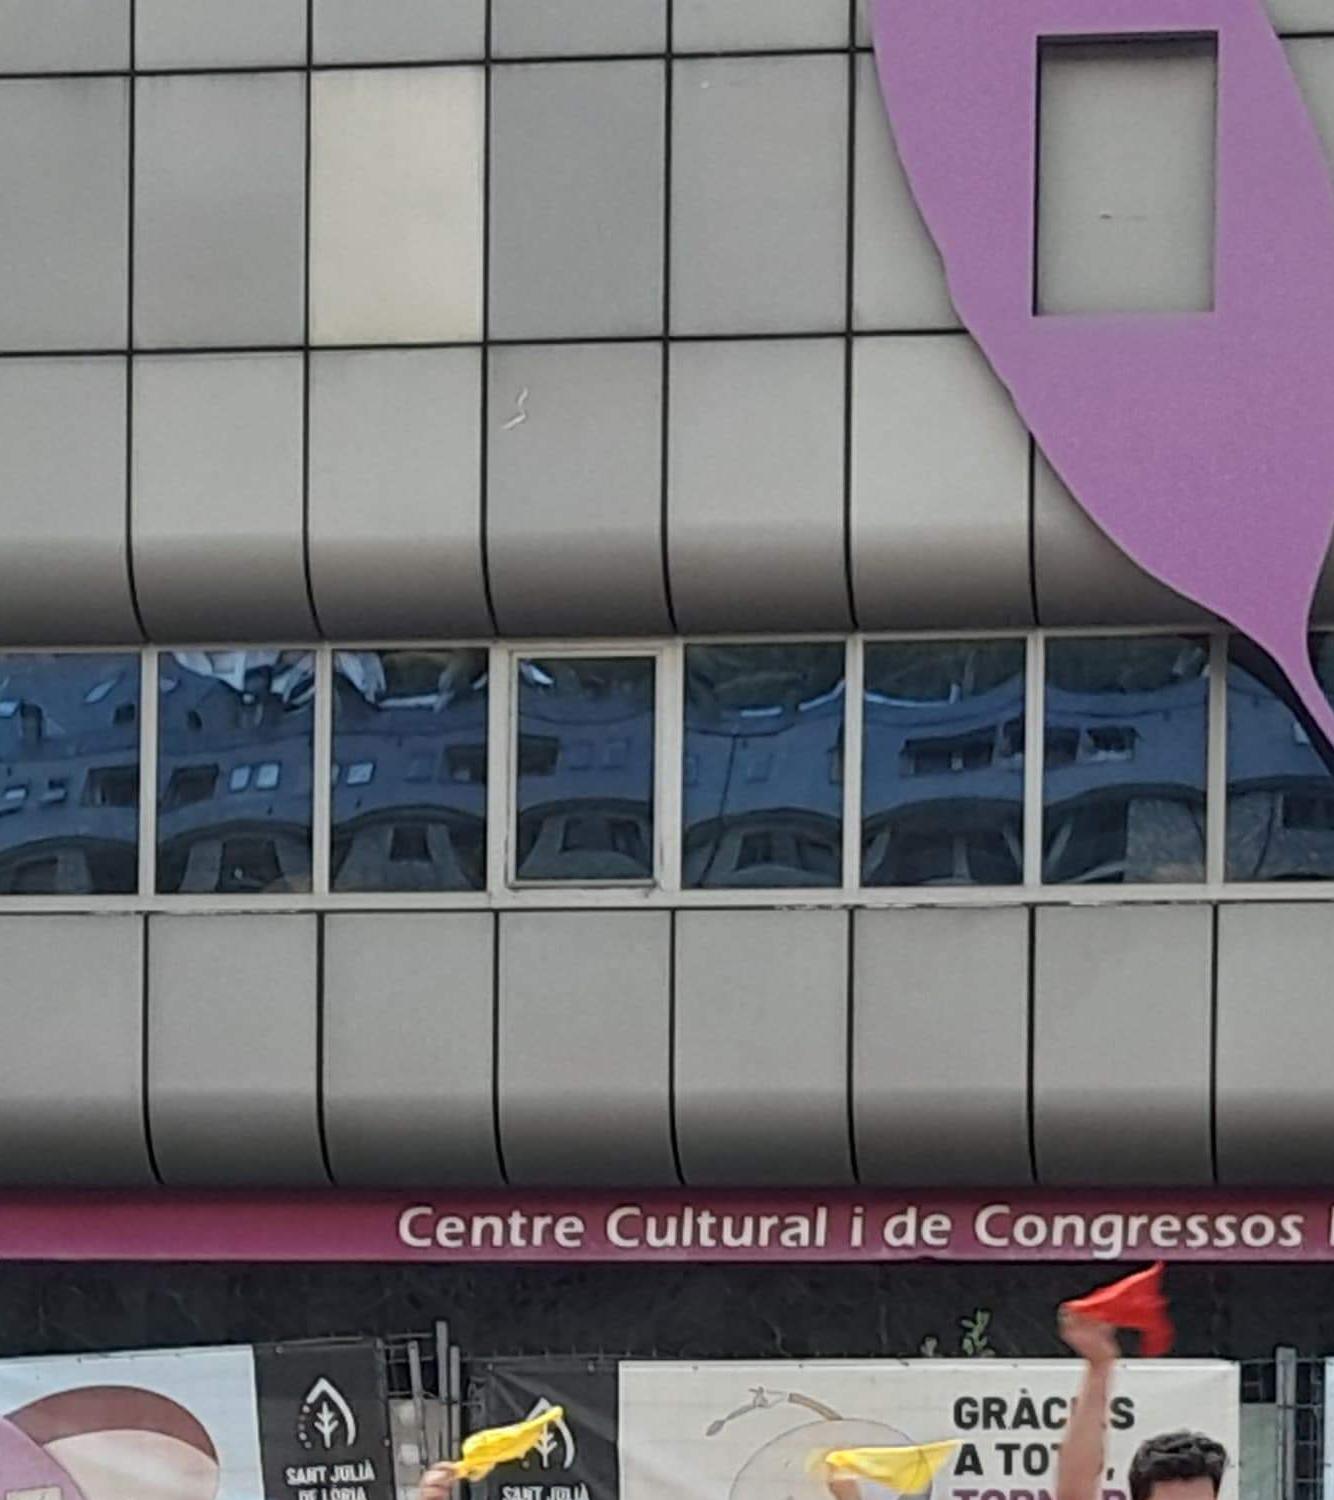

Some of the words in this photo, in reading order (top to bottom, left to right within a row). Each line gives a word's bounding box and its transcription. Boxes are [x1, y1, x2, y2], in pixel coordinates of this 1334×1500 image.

[398, 1206, 585, 1248] Centre
[605, 1206, 828, 1248] Cultural
[850, 1206, 864, 1247] i
[883, 1206, 952, 1248] de
[974, 1204, 1305, 1260] Congressos
[953, 1388, 1135, 1430] GRÀCS
[286, 1466, 327, 1486] SANT
[953, 1443, 983, 1476] A
